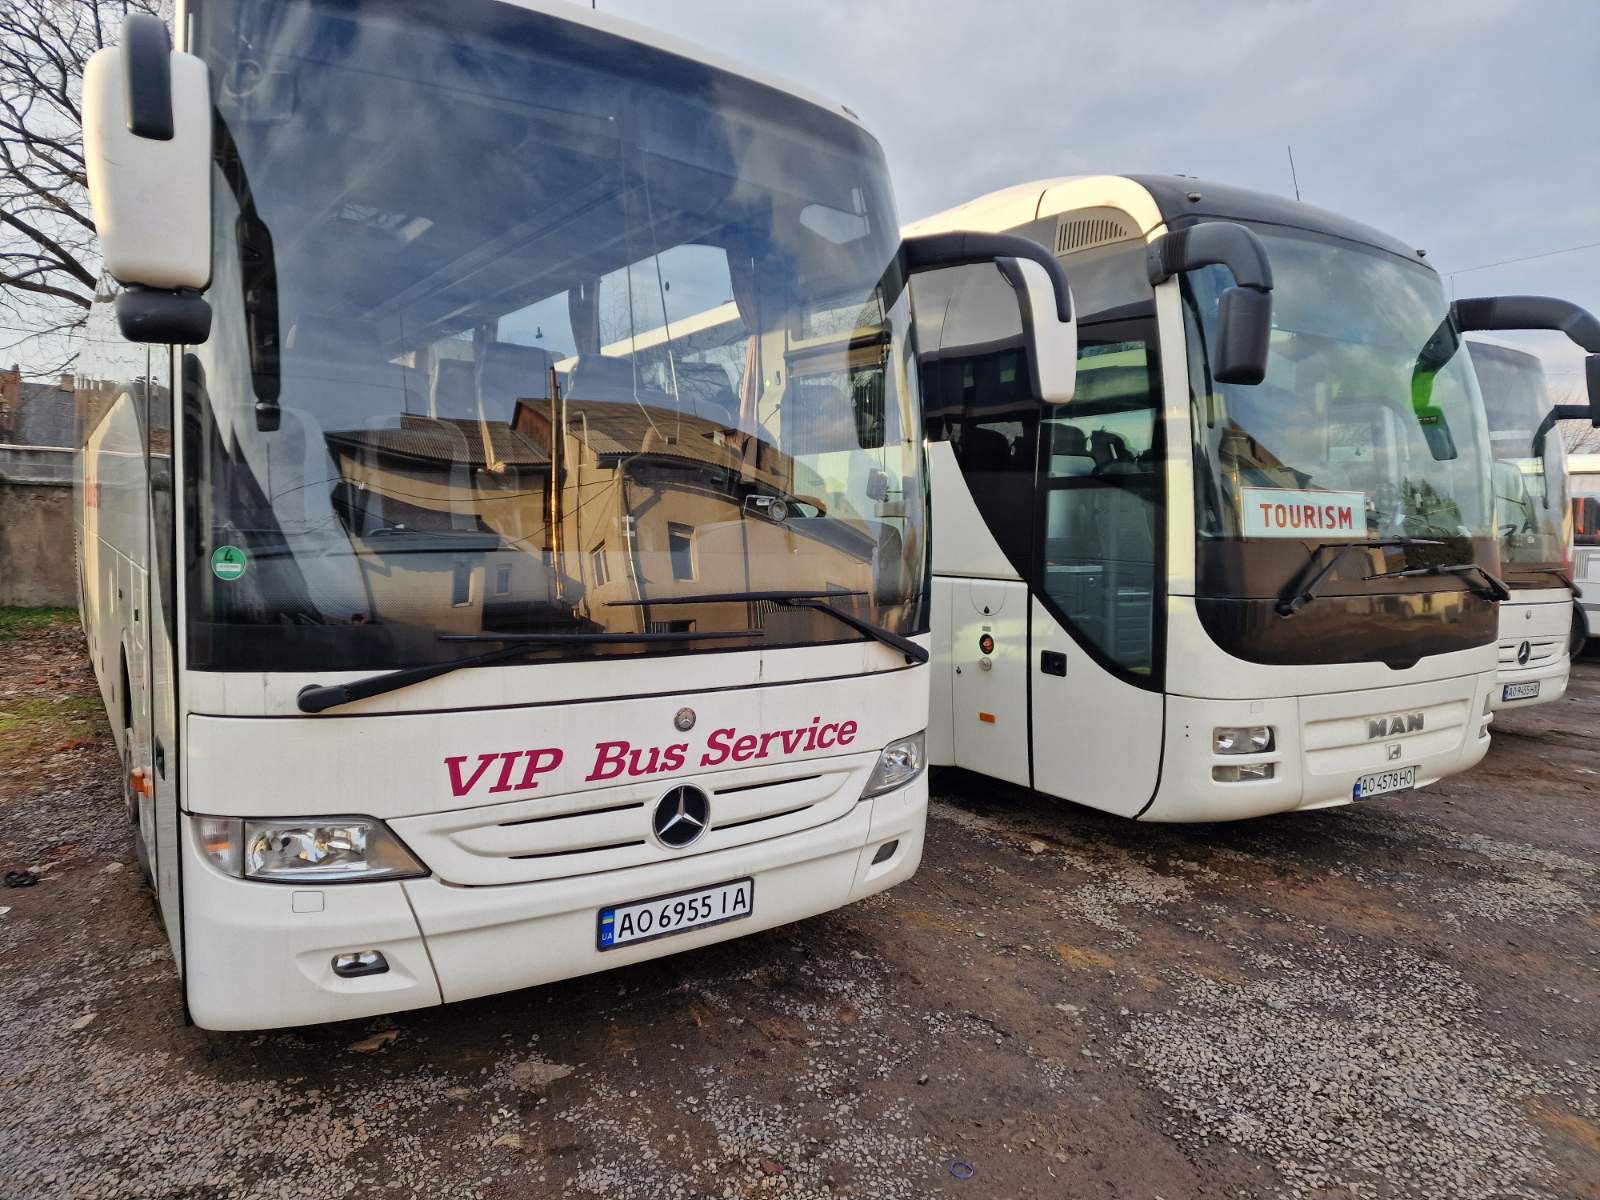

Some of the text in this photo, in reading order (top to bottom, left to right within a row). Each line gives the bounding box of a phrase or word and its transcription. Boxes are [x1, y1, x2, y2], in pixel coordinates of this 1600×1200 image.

[1259, 503, 1353, 529] TOURISM
[224, 548, 234, 563] 4
[1368, 712, 1425, 739] MAN
[443, 716, 858, 797] VIP Bus Service
[618, 909, 654, 939] AO
[658, 894, 713, 929] 6955
[601, 932, 613, 941] UA
